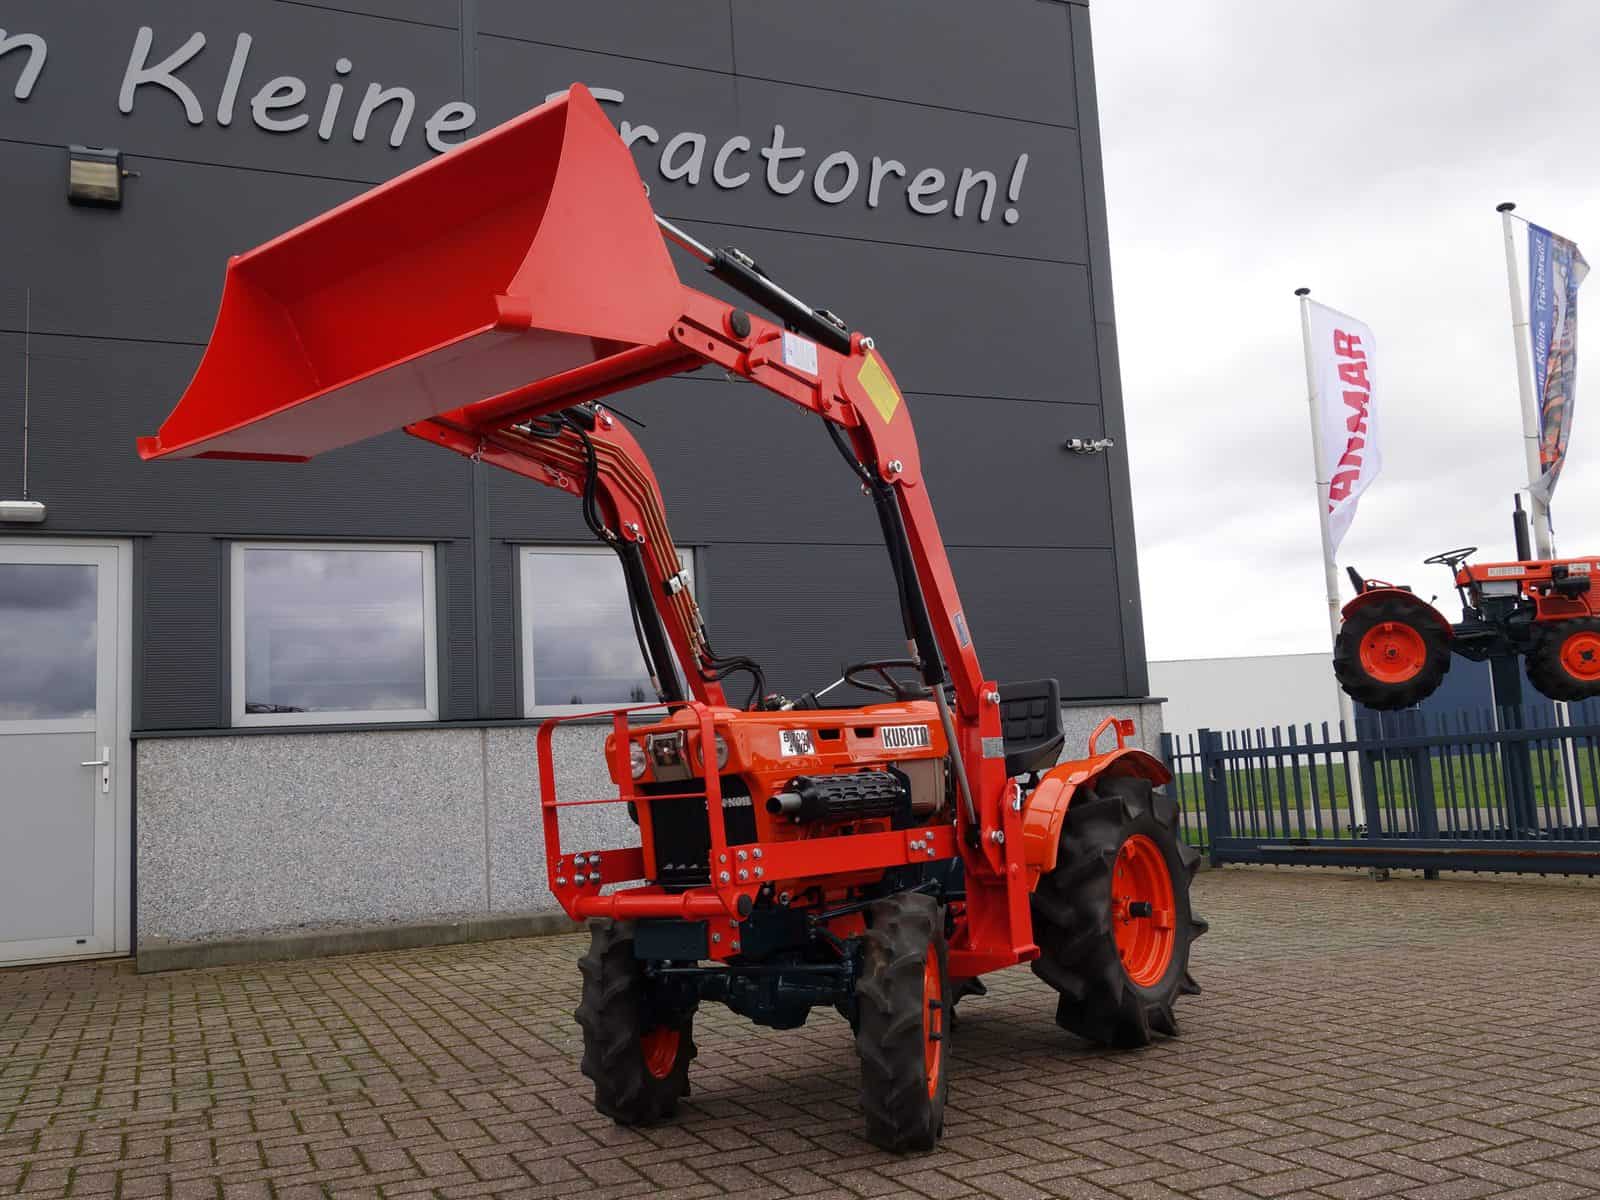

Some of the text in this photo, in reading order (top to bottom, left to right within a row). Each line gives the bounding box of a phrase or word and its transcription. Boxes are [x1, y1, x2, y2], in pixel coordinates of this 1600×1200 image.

[118, 26, 477, 154] Kleine
[1328, 328, 1371, 514] ANMAR
[883, 726, 929, 747] KUBOTA
